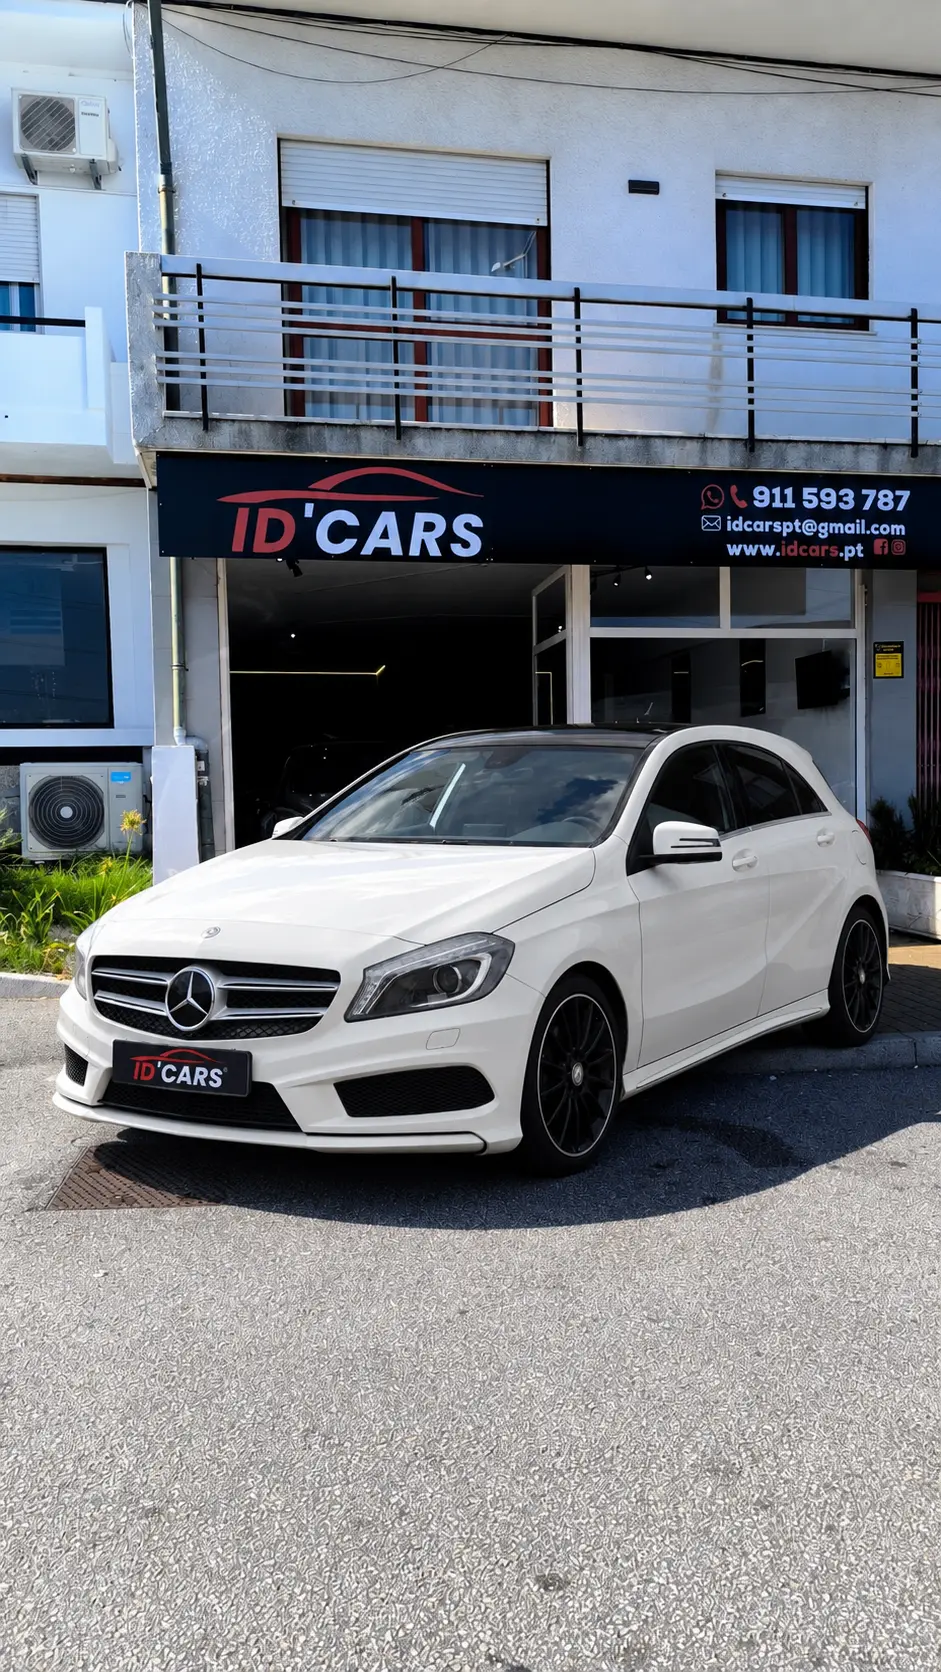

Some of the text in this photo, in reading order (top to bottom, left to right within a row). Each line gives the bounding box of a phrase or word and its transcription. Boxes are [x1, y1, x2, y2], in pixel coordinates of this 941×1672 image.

[753, 485, 911, 511] 911 593 787
[231, 502, 484, 557] ID'CARS
[726, 516, 906, 538] idcarspt@gmail.com
[726, 540, 864, 561] www.idcars.pt
